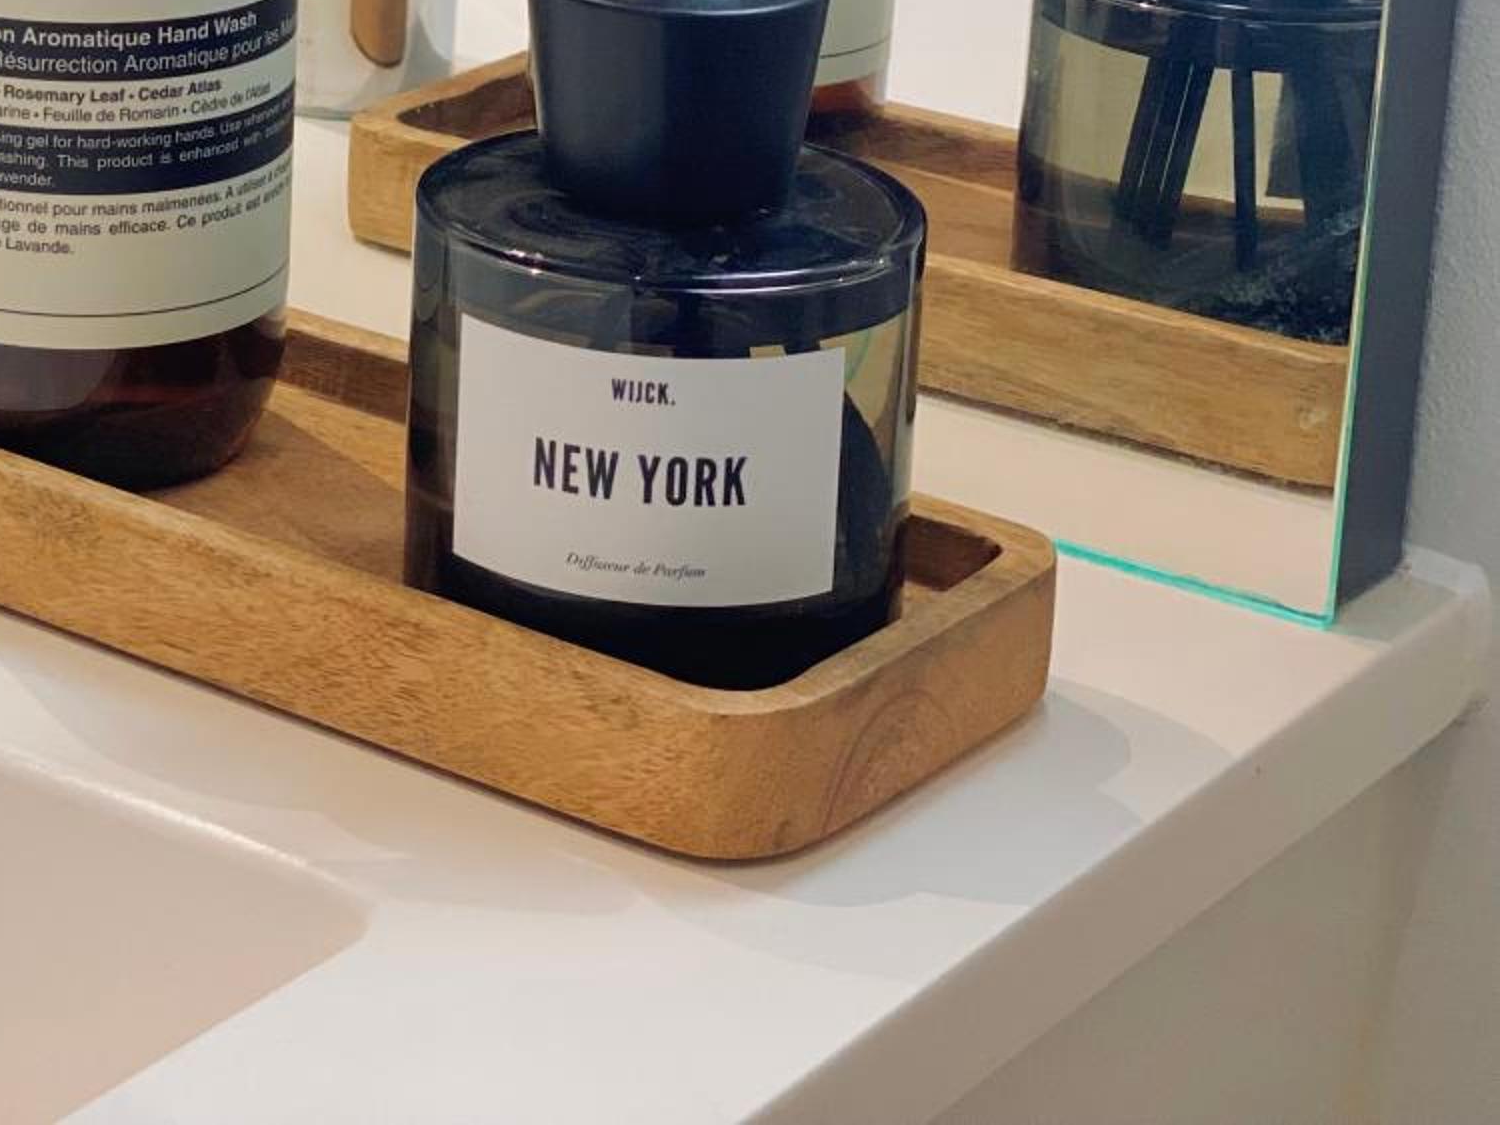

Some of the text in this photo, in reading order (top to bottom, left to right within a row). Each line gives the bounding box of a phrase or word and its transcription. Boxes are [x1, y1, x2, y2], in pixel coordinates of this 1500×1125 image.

[21, 26, 151, 51] Aromatique
[157, 20, 210, 44] Hand
[213, 11, 258, 35] Wash
[123, 44, 229, 74] Aromatique
[231, 35, 263, 62] pour
[3, 84, 85, 106] Rosemary
[90, 88, 126, 103] Leaf
[138, 84, 185, 101] Cedar
[187, 78, 223, 96] Atlas
[43, 106, 92, 123] Feuille
[95, 109, 115, 122] de
[119, 105, 179, 122] Romarin
[27, 135, 49, 150] gel
[52, 134, 72, 148] for
[77, 132, 173, 151] hard-working
[57, 154, 88, 168] This
[97, 153, 153, 171] product
[179, 139, 240, 163] enhanced
[27, 220, 47, 234] de
[54, 222, 101, 236] mains
[176, 214, 196, 229] Ce
[201, 201, 242, 228] produit
[52, 203, 87, 217] pour
[91, 202, 137, 217] mains
[611, 378, 676, 406] WIJCK.
[533, 436, 748, 507] NEW YORK
[565, 552, 706, 581] Diffuseur de Parfum
